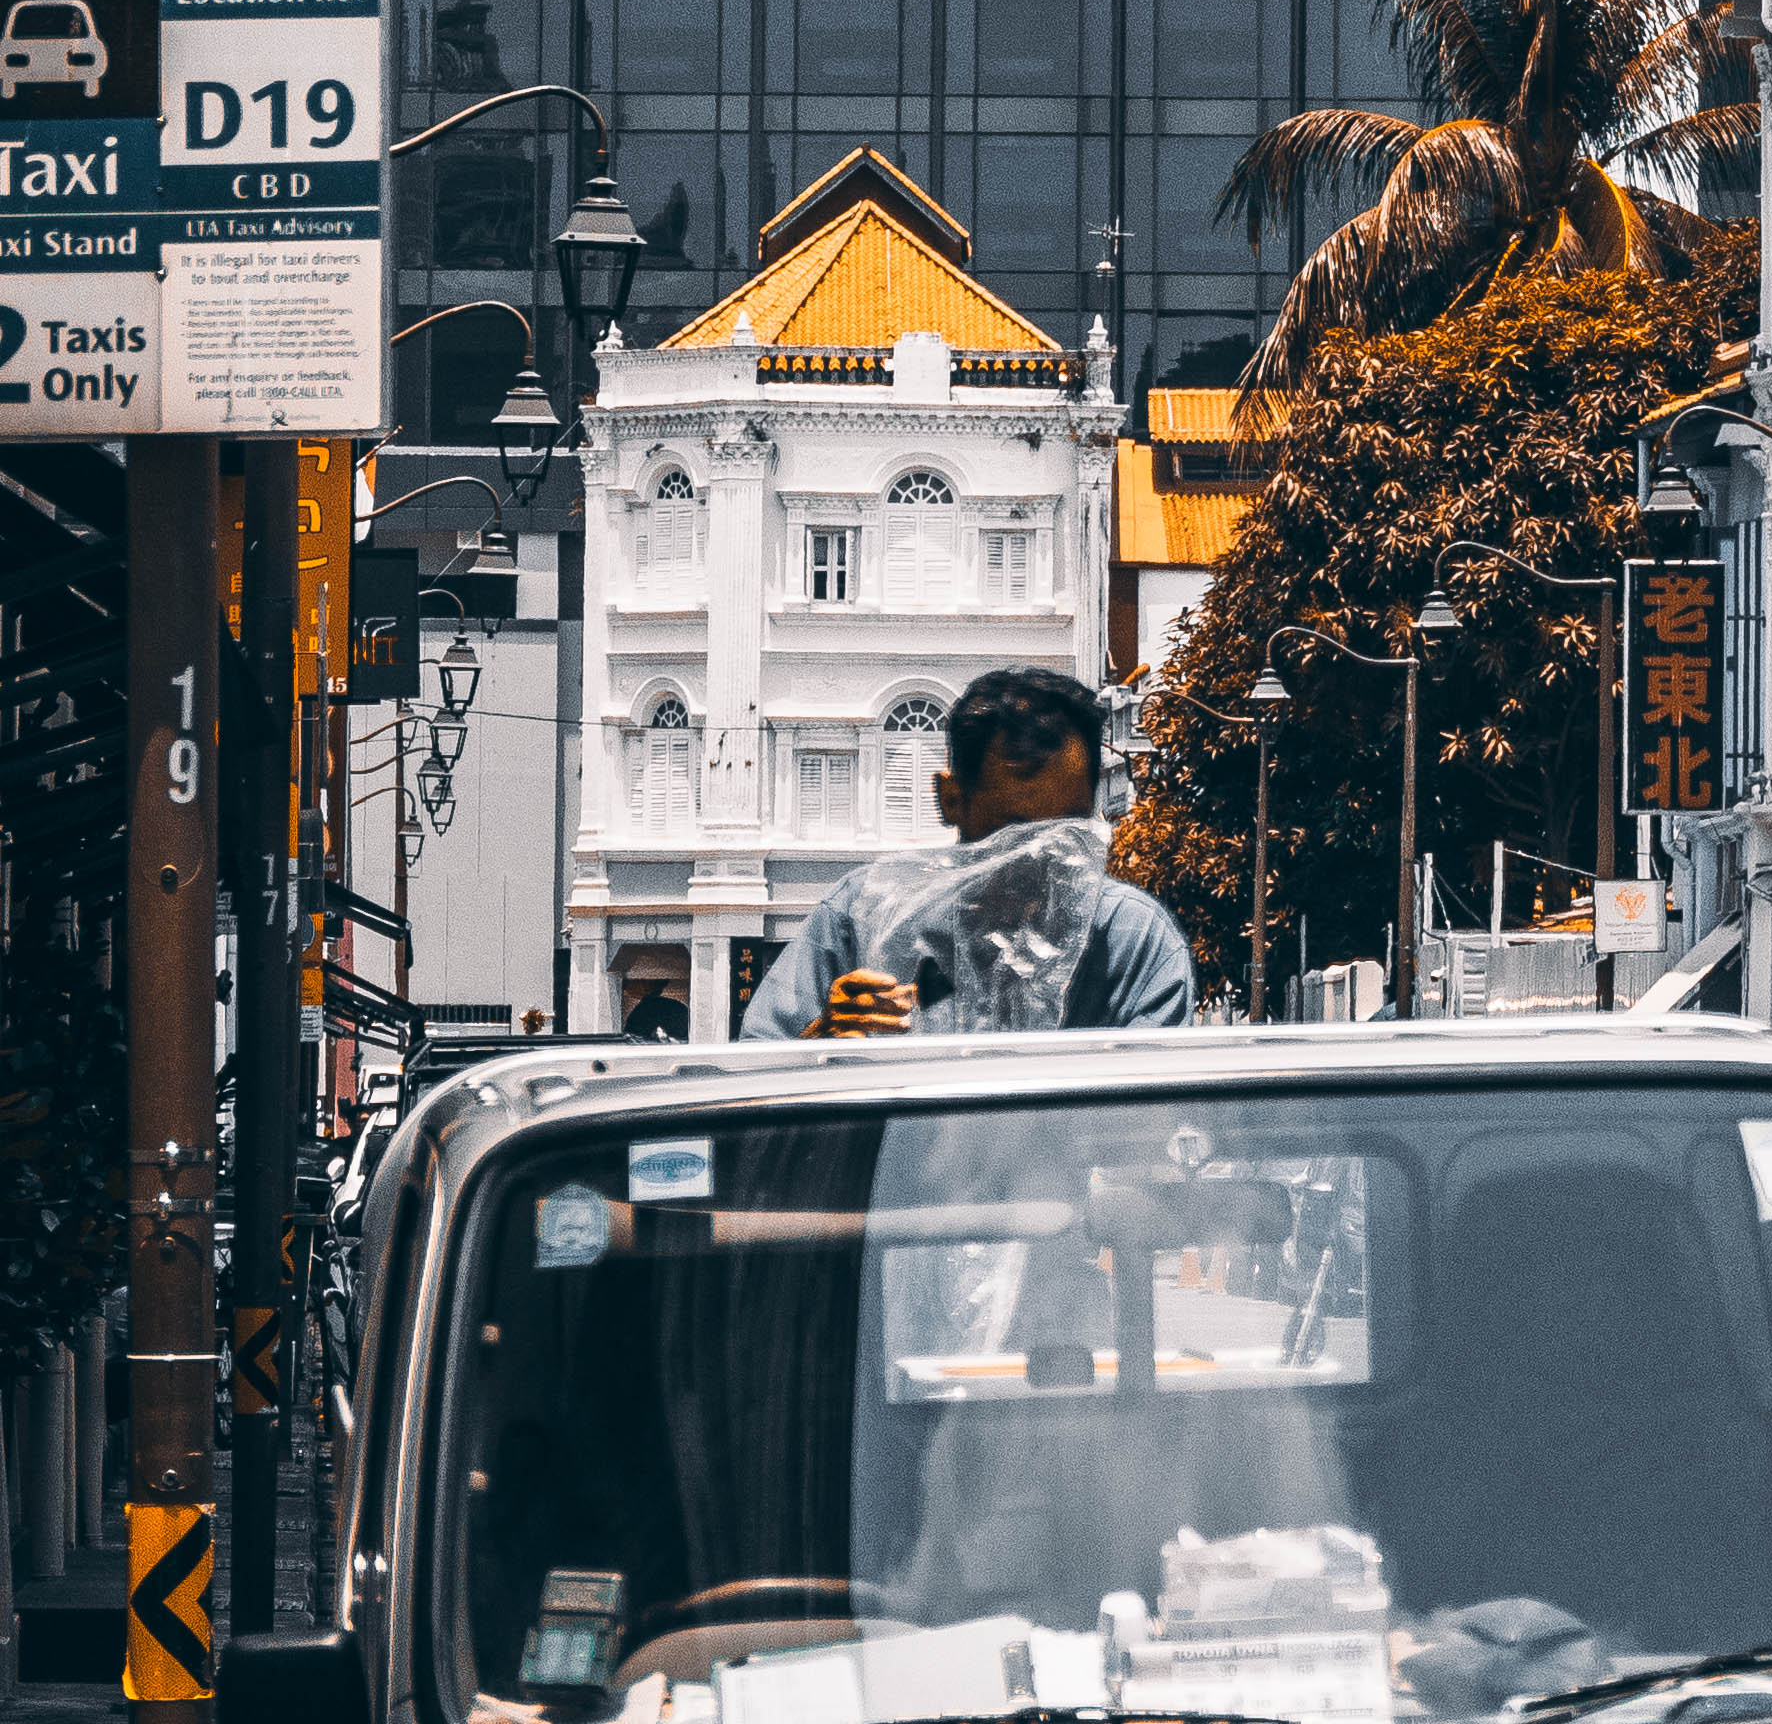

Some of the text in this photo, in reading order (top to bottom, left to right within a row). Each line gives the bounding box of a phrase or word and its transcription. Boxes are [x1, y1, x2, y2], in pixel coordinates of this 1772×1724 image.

[186, 79, 356, 150] D19
[0, 136, 118, 197] Taxi
[0, 227, 137, 257] xi Stand
[186, 217, 355, 238] LTA Taxi Advisory
[312, 252, 361, 265] drivers
[41, 316, 146, 354] Taxis
[43, 363, 139, 409] Only
[1642, 575, 1715, 810] 老東北
[168, 664, 200, 804] 19
